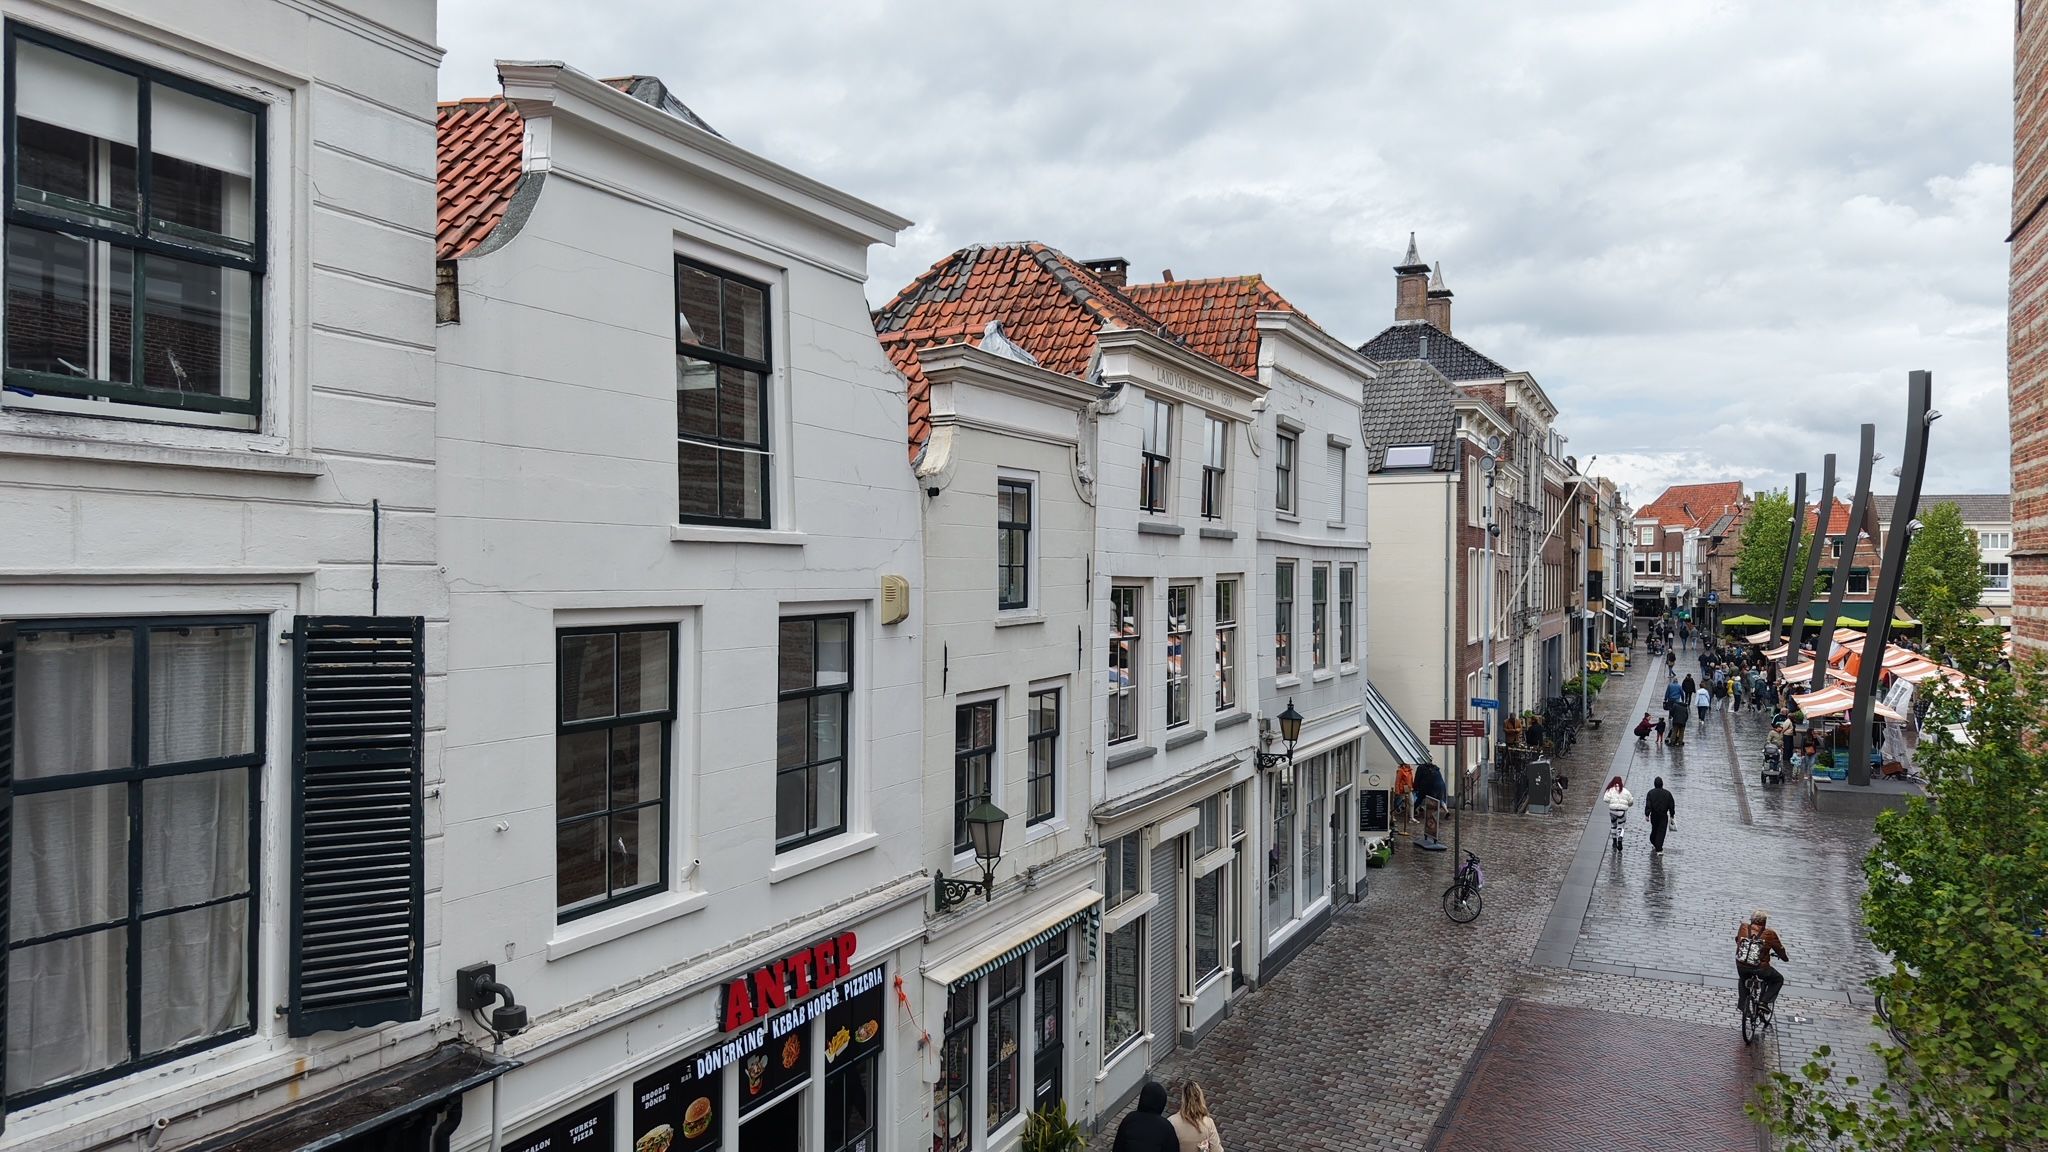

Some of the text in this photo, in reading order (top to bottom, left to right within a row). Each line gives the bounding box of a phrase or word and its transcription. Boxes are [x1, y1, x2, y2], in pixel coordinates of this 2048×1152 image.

[1157, 367, 1174, 386] LAND
[1174, 373, 1186, 391] VAN
[1187, 379, 1214, 400] BELOFTEN
[720, 931, 857, 1033] ANTEP
[697, 1027, 764, 1080] DÖNERKING
[772, 1006, 806, 1039] KEBAB
[807, 987, 839, 1020] HOUSE
[844, 967, 883, 1000] PIZZERIA
[641, 1083, 670, 1103] BROODJE
[644, 1093, 667, 1110] DÖNER
[569, 1117, 598, 1137] TURKSE
[573, 1128, 594, 1144] PIZZA
